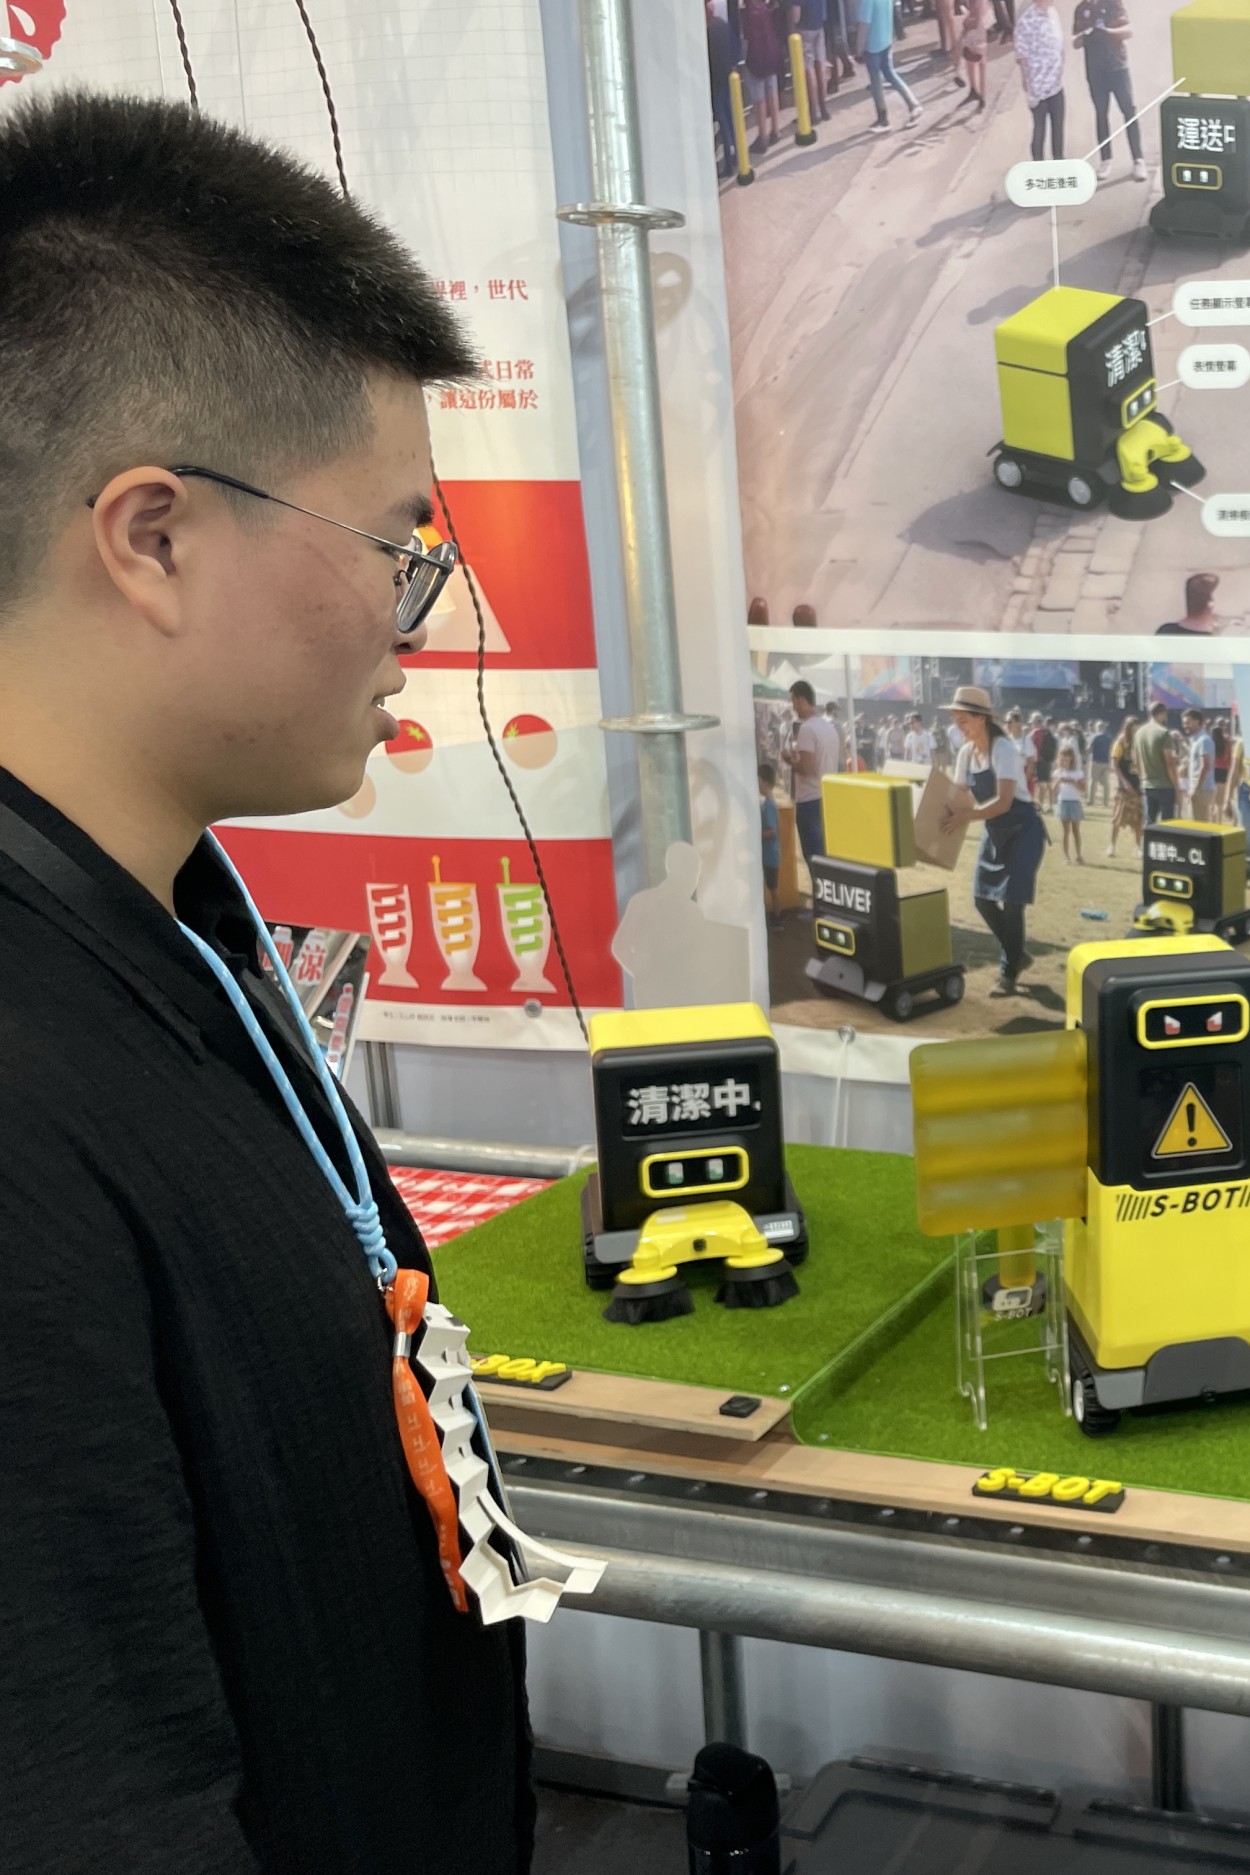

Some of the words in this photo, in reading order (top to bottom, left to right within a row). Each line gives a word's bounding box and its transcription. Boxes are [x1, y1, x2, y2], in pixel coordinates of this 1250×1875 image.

[1104, 329, 1147, 388] 清潔
[1150, 1186, 1242, 1217] S-BOT
[976, 1467, 1123, 1505] S-BOT
